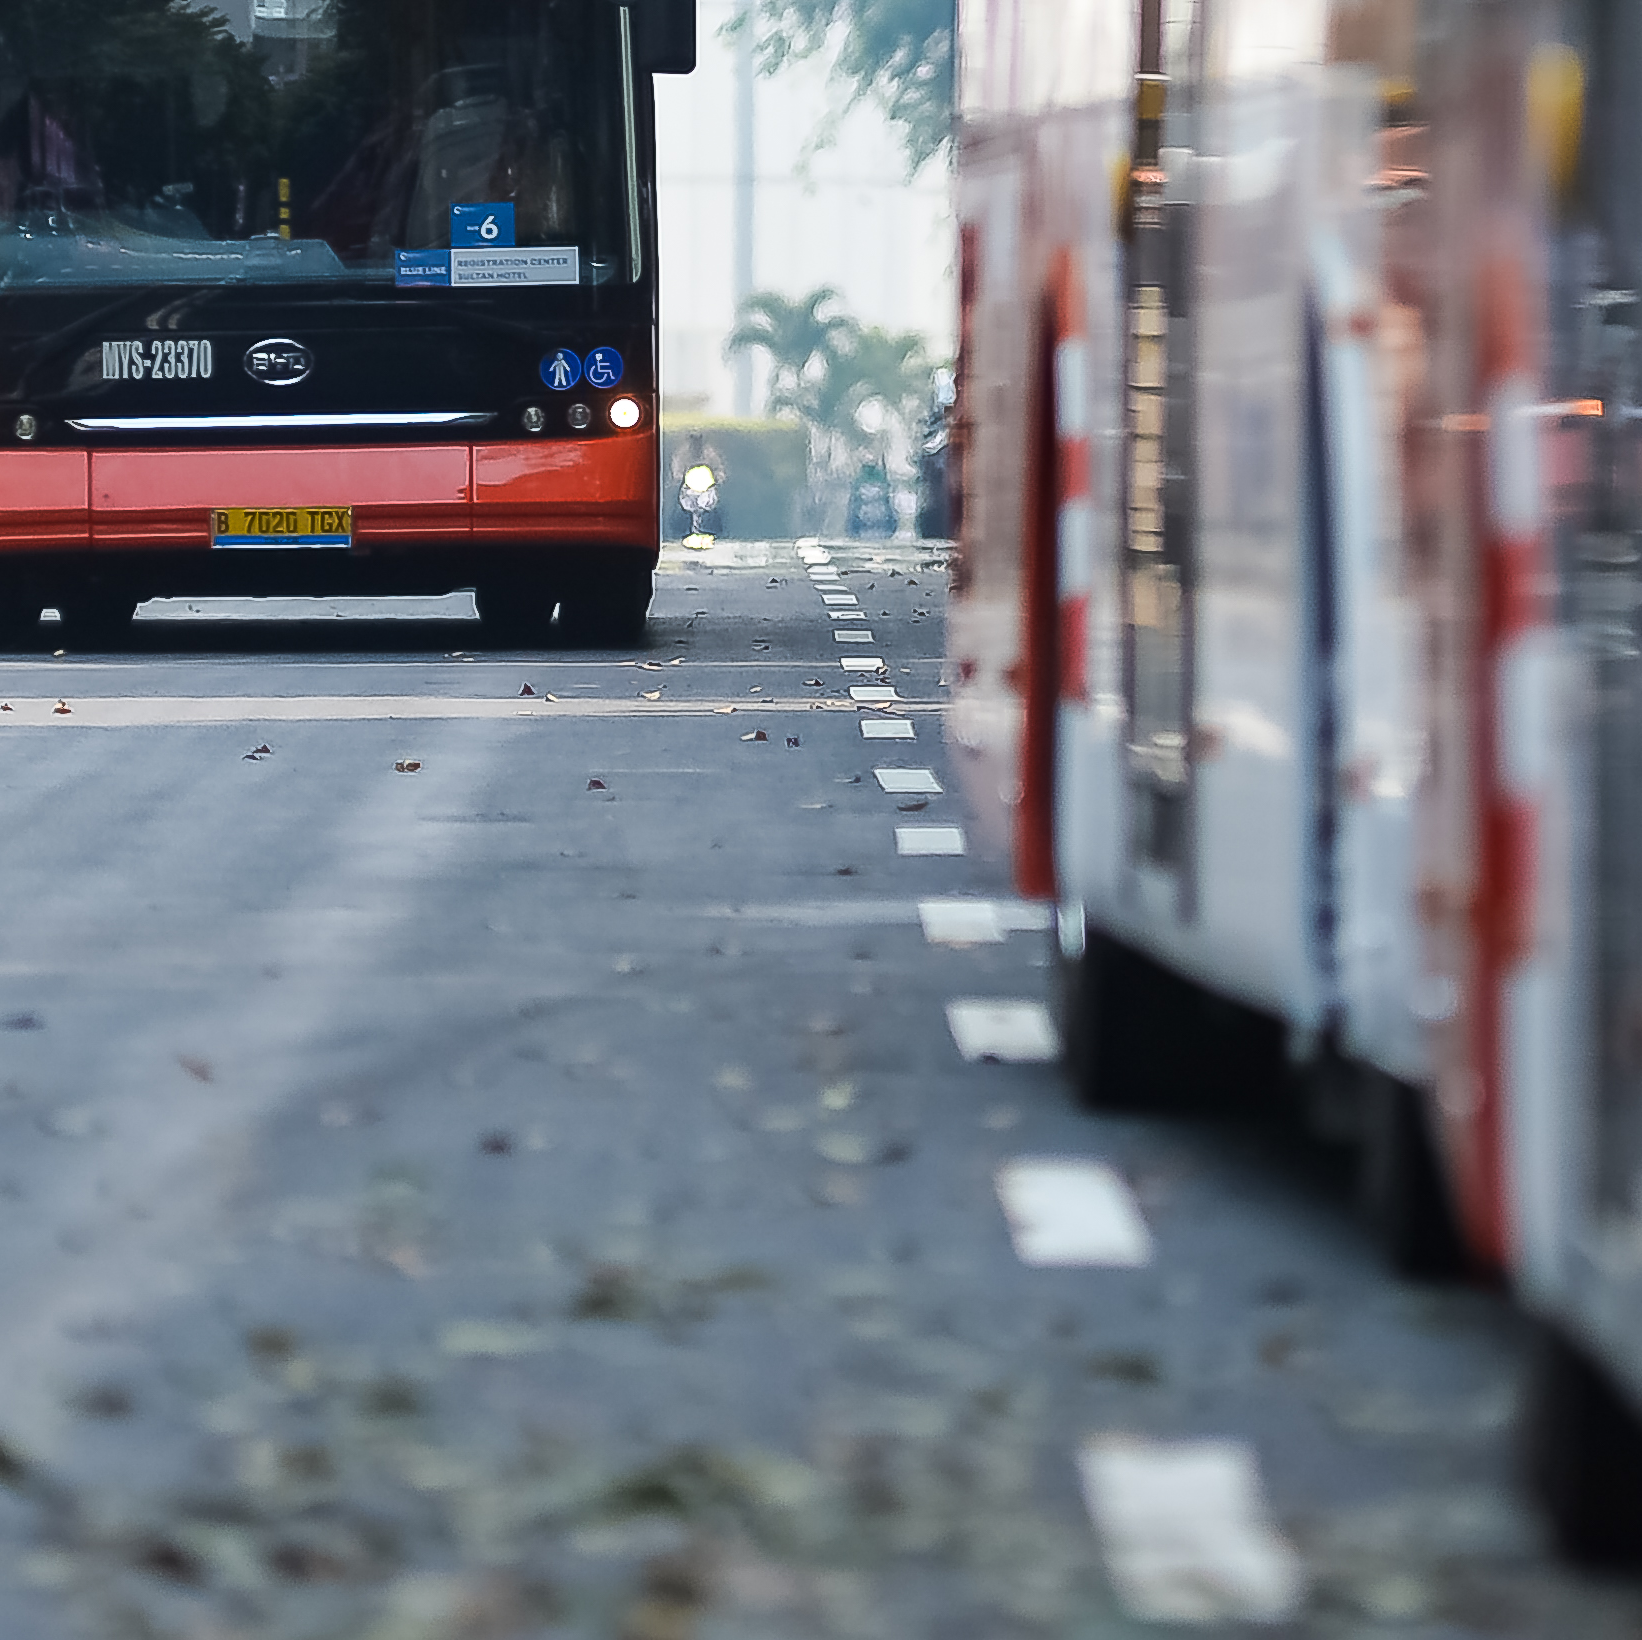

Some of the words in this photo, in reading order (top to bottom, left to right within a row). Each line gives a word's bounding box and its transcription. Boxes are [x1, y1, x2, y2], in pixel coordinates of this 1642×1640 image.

[480, 215, 499, 240] 6
[457, 258, 529, 268] REGISTRATION
[529, 257, 569, 266] CENTER
[457, 272, 495, 281] SULTAN
[496, 271, 528, 280] HOTEL
[102, 340, 212, 379] MYS-23370
[216, 511, 229, 533] B
